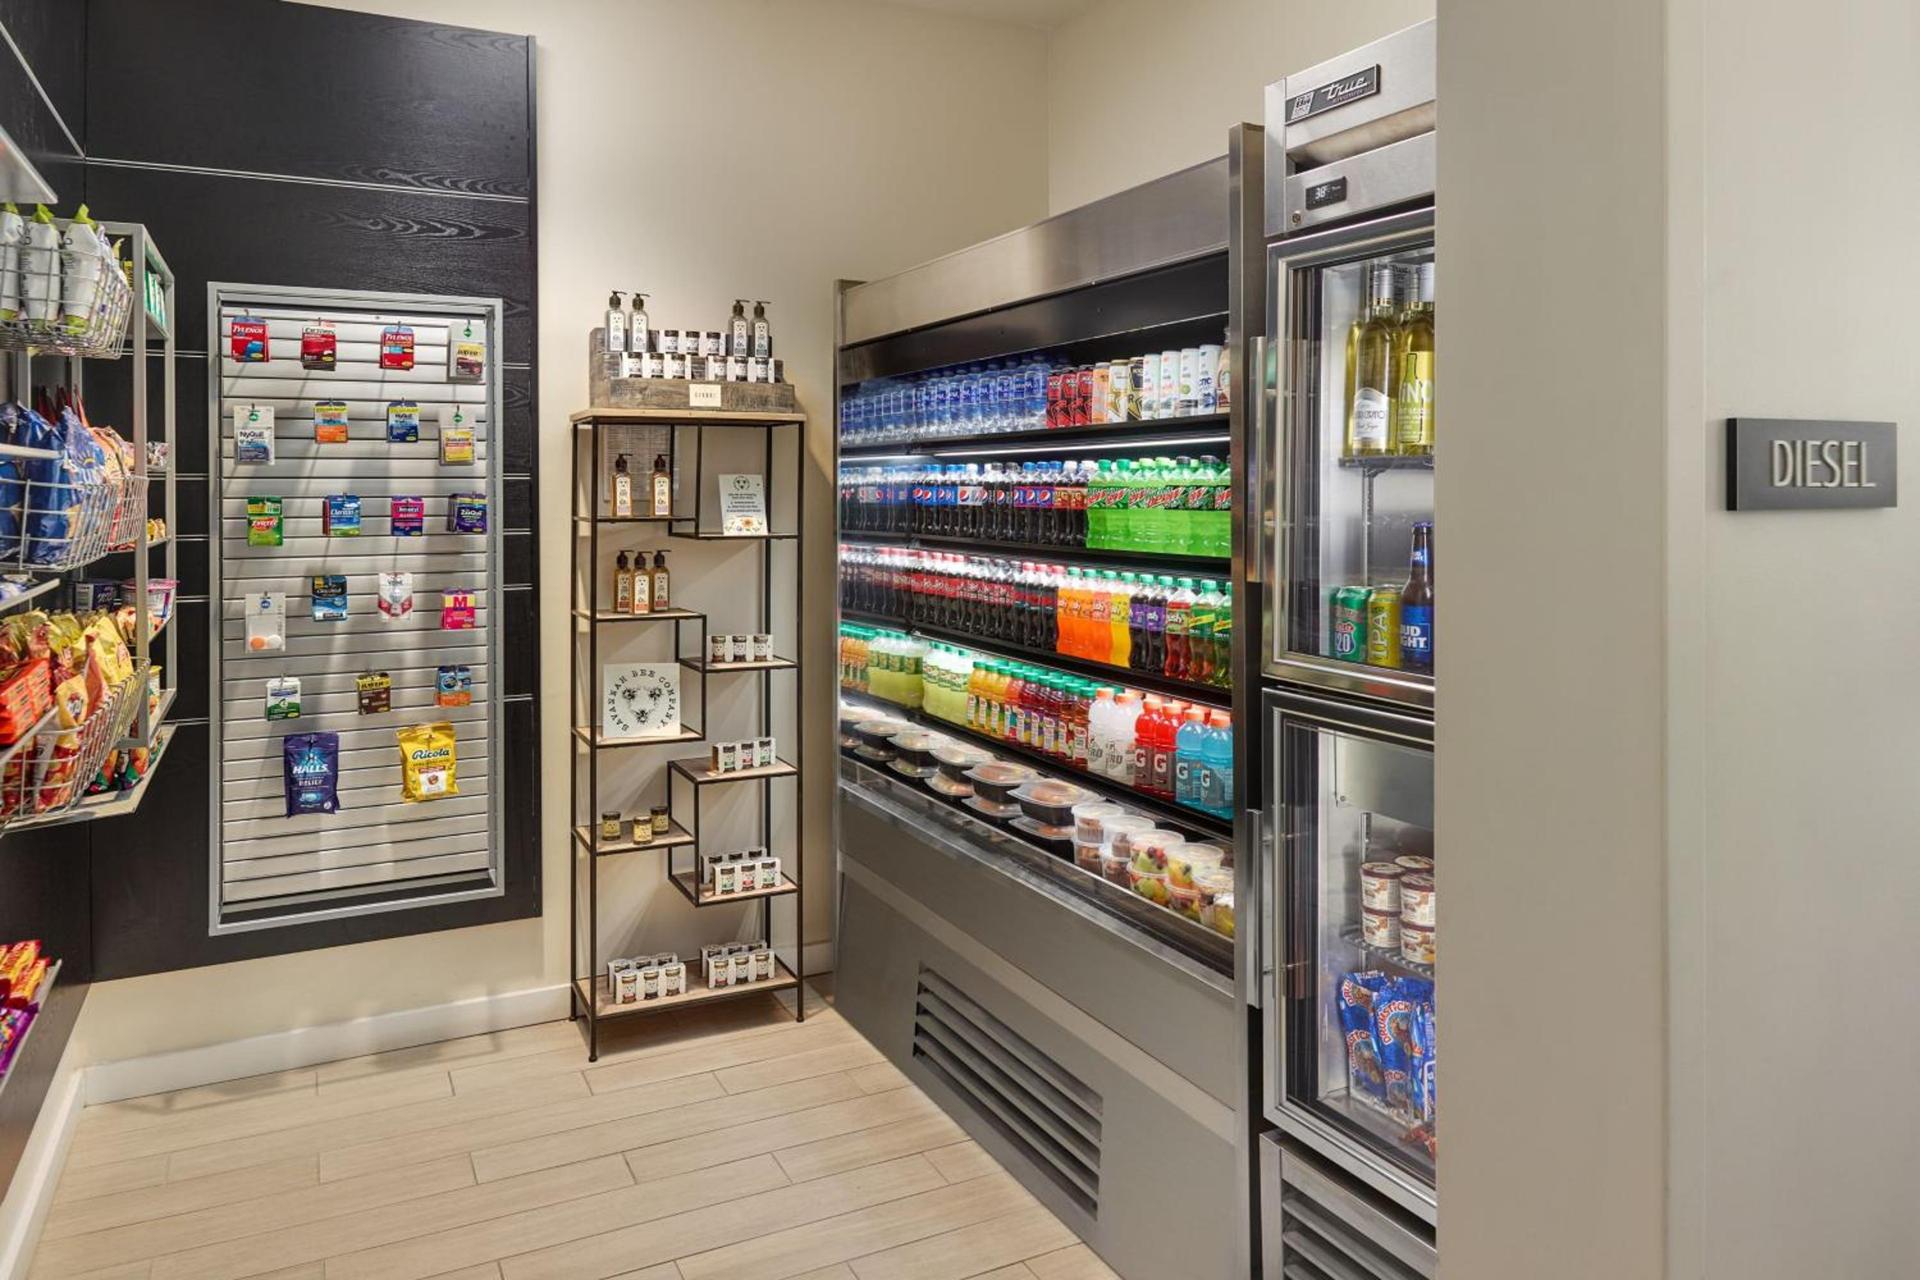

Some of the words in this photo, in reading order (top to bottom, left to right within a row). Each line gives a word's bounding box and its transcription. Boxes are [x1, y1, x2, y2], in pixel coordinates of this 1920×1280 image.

[1773, 440, 1876, 487] DIESEL
[412, 748, 449, 760] Ricola
[1154, 753, 1167, 772] G
[293, 764, 330, 774] HALLS
[1176, 762, 1188, 779] G
